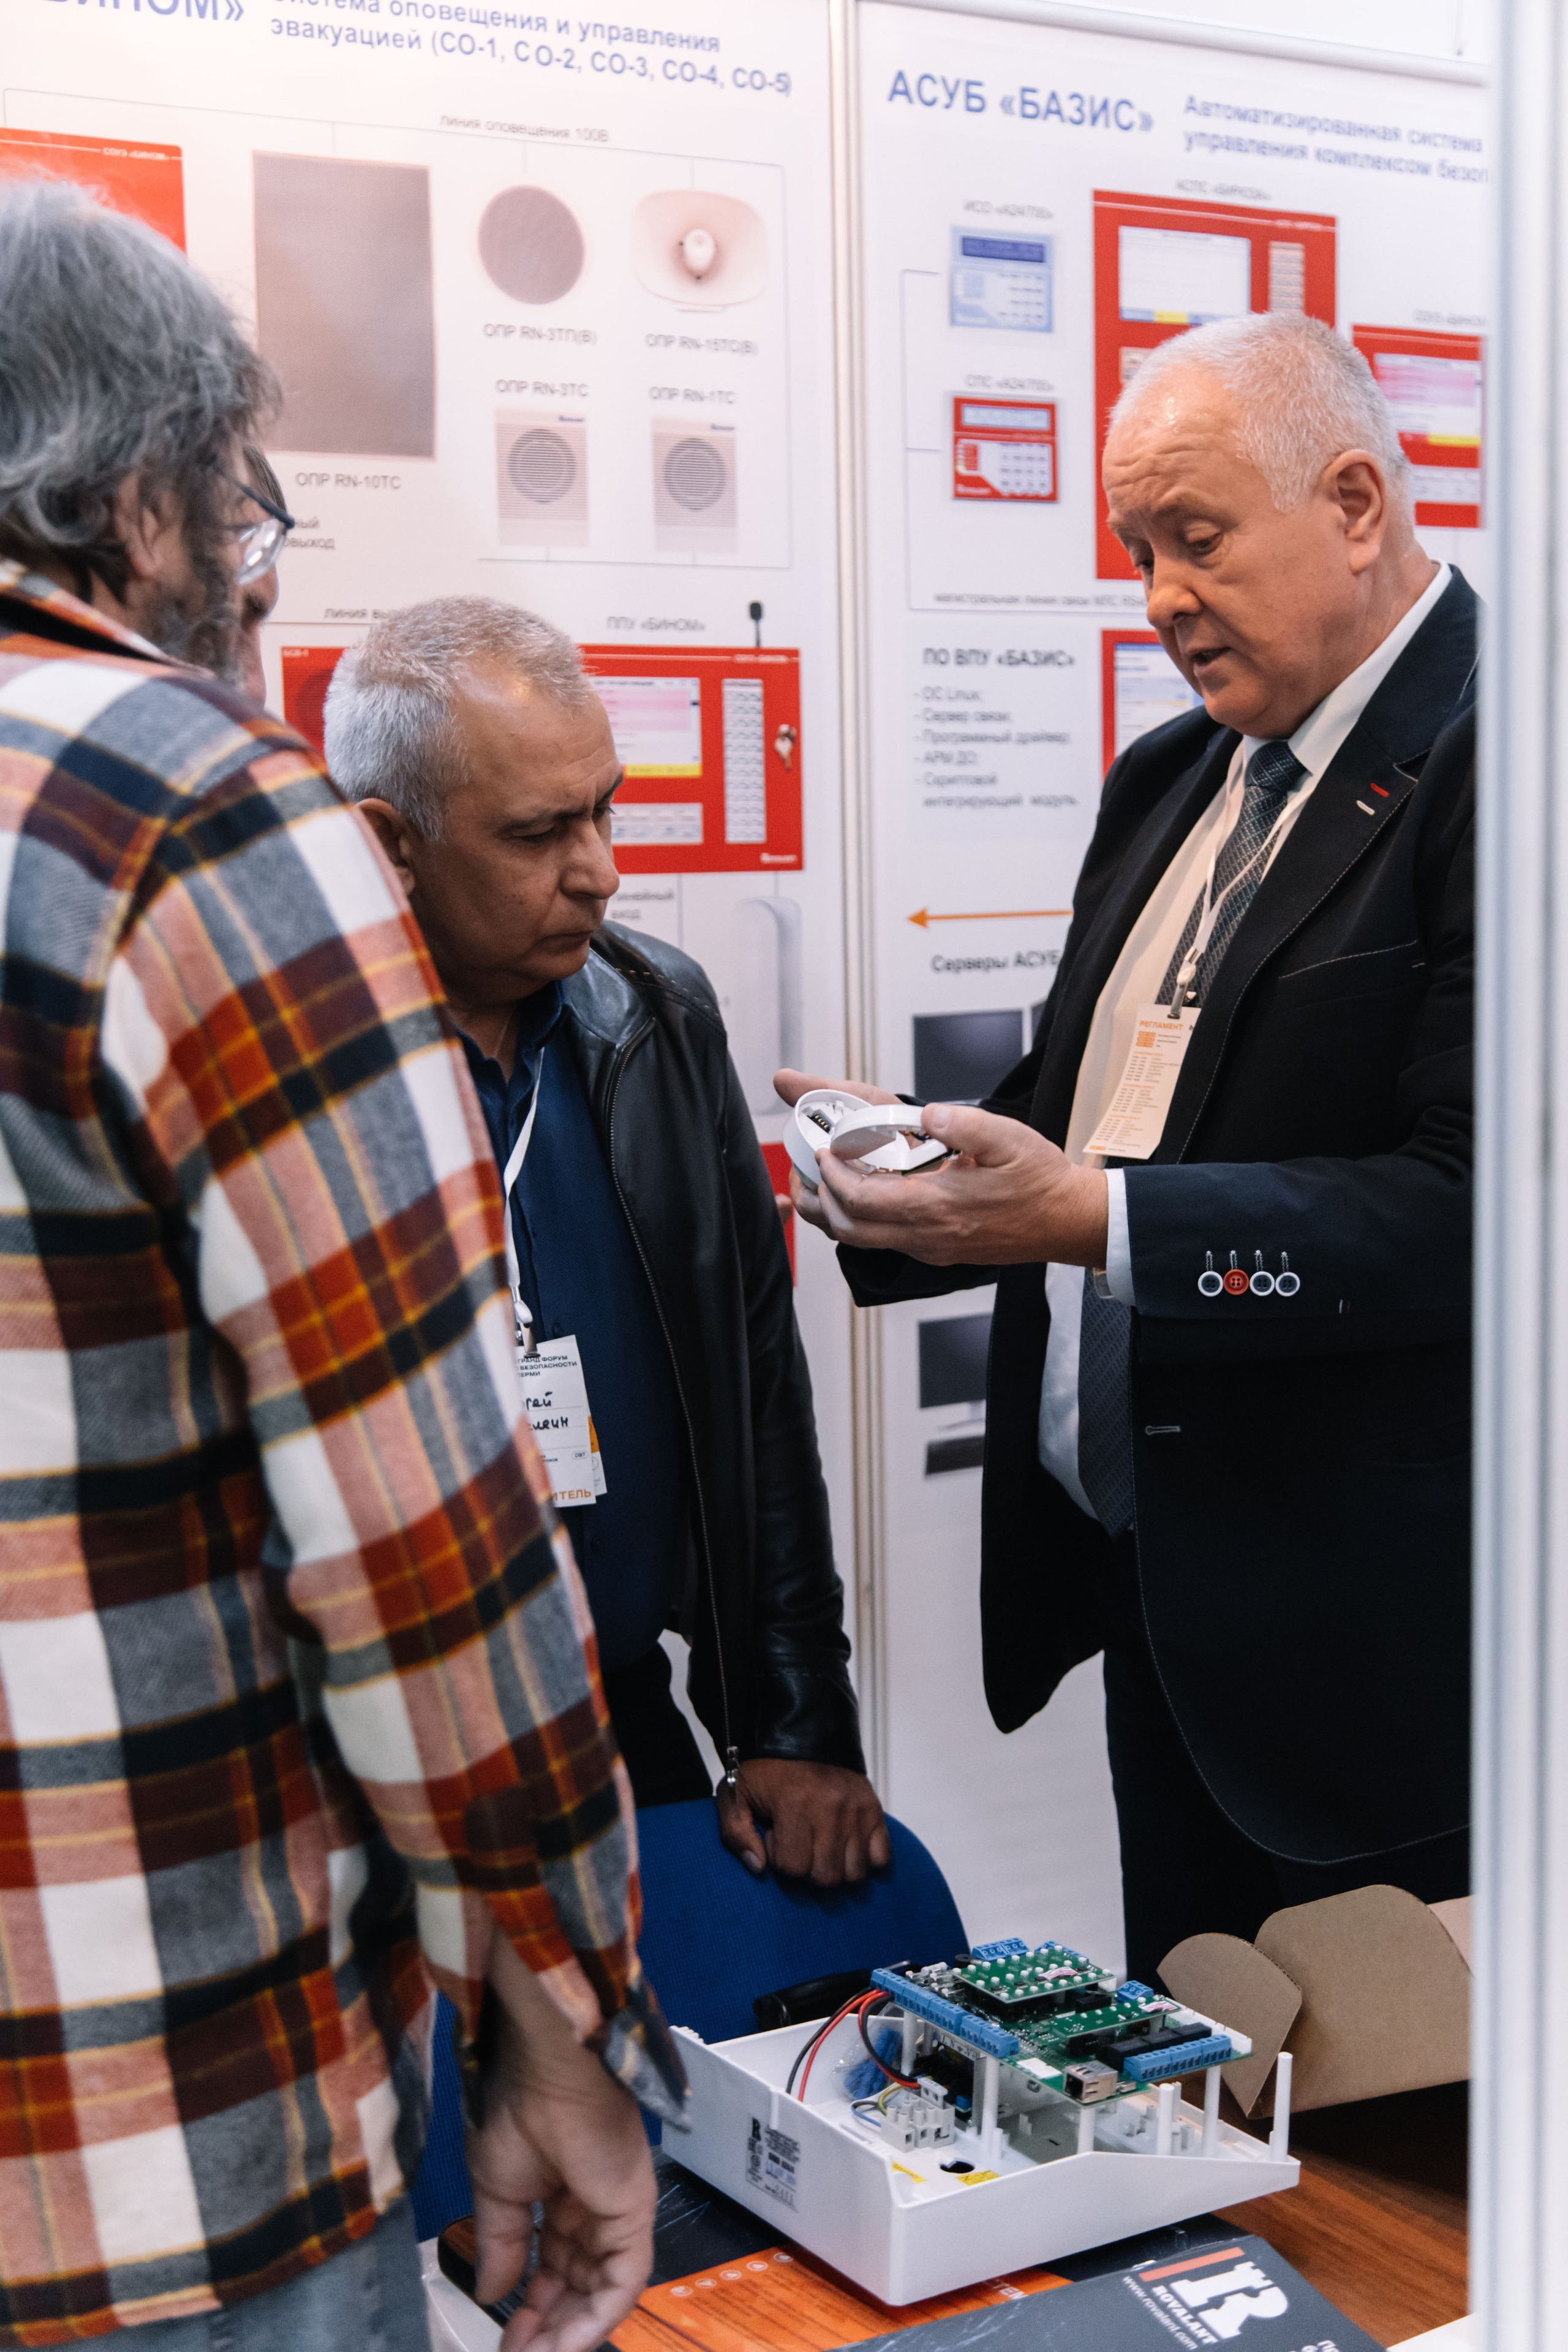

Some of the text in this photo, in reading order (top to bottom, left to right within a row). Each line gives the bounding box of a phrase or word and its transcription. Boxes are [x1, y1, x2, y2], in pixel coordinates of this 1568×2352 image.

[390, 0, 548, 32] оповещения
[557, 19, 570, 34] и
[578, 21, 721, 52] управления
[271, 18, 793, 97] эвакуацией (СО-1, СО-2, СО-3, СО-4, СО-5)
[889, 69, 1155, 132] АСУБ «БАЗИС»
[486, 121, 570, 138] оповещения
[1184, 94, 1483, 153] Автоматизированная система
[1183, 130, 1308, 159] управления
[1314, 146, 1432, 176] комплексом
[483, 323, 516, 337] ОПР
[645, 334, 676, 347] ОПР
[496, 379, 528, 393] ОПР
[649, 386, 679, 400] ОПР
[295, 472, 330, 486] ОПР
[641, 617, 706, 632] «БИНОМ»
[922, 648, 1076, 666] ПО ВПУ «БАЗИС»
[930, 954, 1008, 974] Серверы
[1139, 1020, 1183, 1030] РЕГЛАМЕНТ
[520, 1361, 578, 1371] БЕЗОПАСНОСТИ
[1152, 2285, 1219, 2345] ROVALANT
